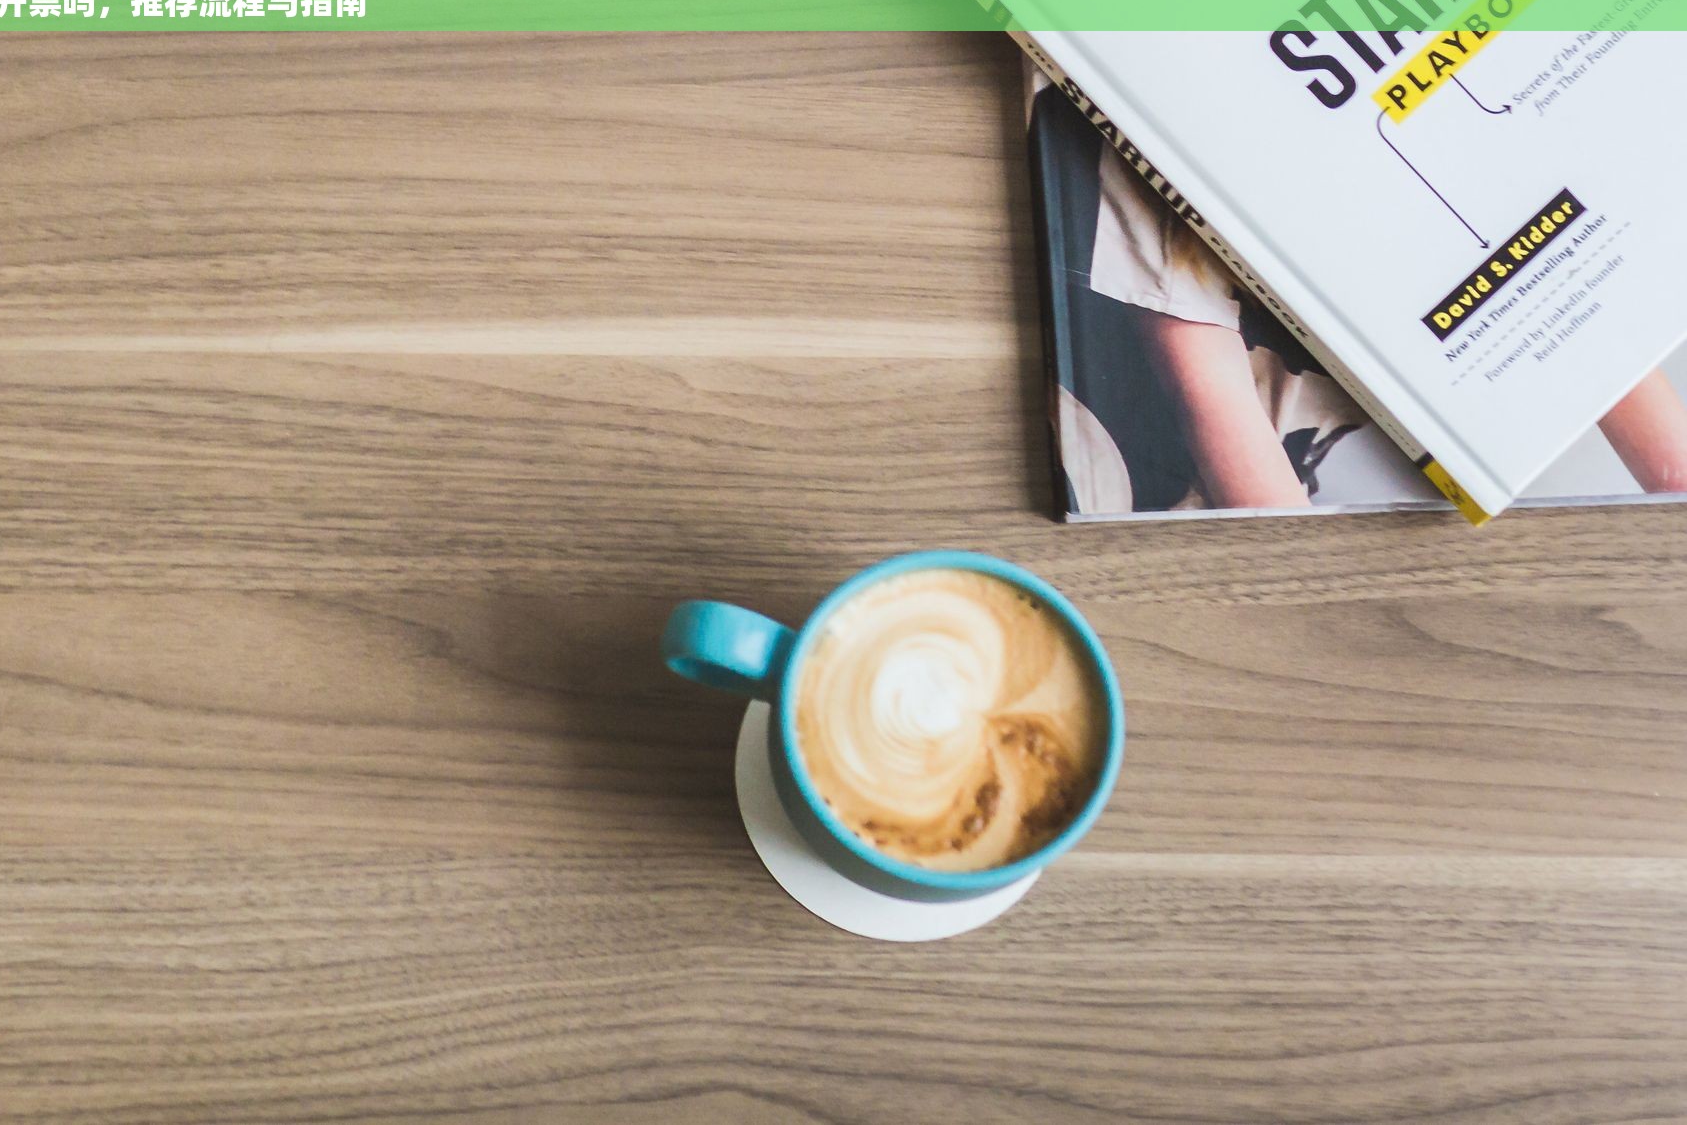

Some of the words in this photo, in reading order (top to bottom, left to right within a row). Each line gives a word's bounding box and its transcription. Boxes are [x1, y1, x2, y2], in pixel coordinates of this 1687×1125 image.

[1512, 71, 1551, 105] Secrets
[1551, 56, 1563, 72] of
[1561, 45, 1579, 61] the
[1534, 89, 1560, 117] from
[1555, 64, 1588, 89] Their
[1584, 20, 1638, 64] Founding
[1061, 77, 1206, 228] STARTUP
[1210, 237, 1309, 338] PLAYBOOK
[1433, 275, 1492, 329] David
[1490, 261, 1513, 277] S.
[1508, 201, 1573, 260] Kidder
[1445, 341, 1468, 362] New
[1467, 320, 1490, 341] York
[1488, 297, 1519, 321] Times
[1516, 247, 1575, 296] Bestselling
[1572, 215, 1606, 247] Author
[1484, 338, 1532, 382] Foreword
[1528, 329, 1544, 341] by
[1542, 290, 1587, 329] LinkedIn
[1585, 255, 1624, 290] founder
[1533, 339, 1559, 362] Reid
[1556, 302, 1602, 341] Hoffman
